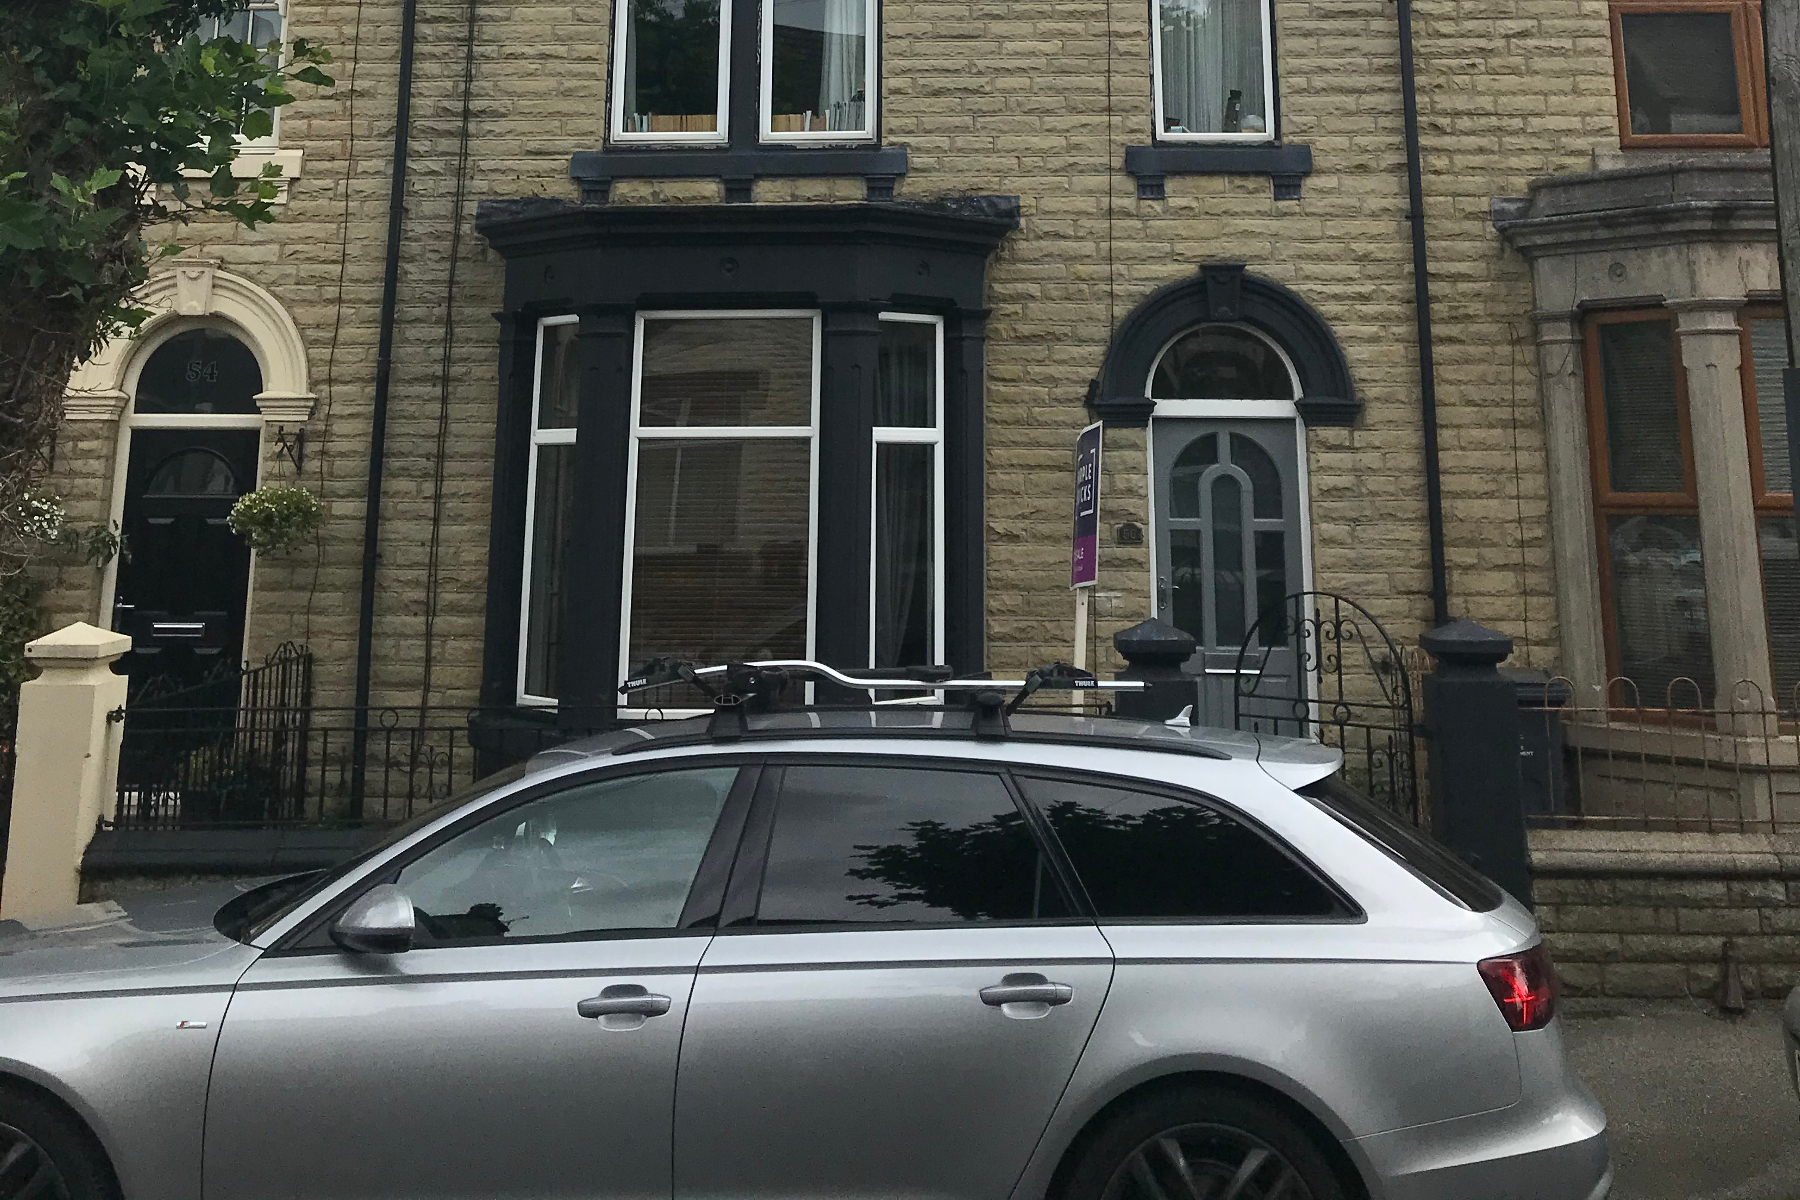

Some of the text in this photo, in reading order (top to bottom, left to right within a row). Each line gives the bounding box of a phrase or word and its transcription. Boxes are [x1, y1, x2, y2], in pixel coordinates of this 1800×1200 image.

[185, 360, 218, 382] 54
[1077, 463, 1092, 484] PLE
[1076, 484, 1091, 504] CKS
[627, 678, 647, 687] THULE
